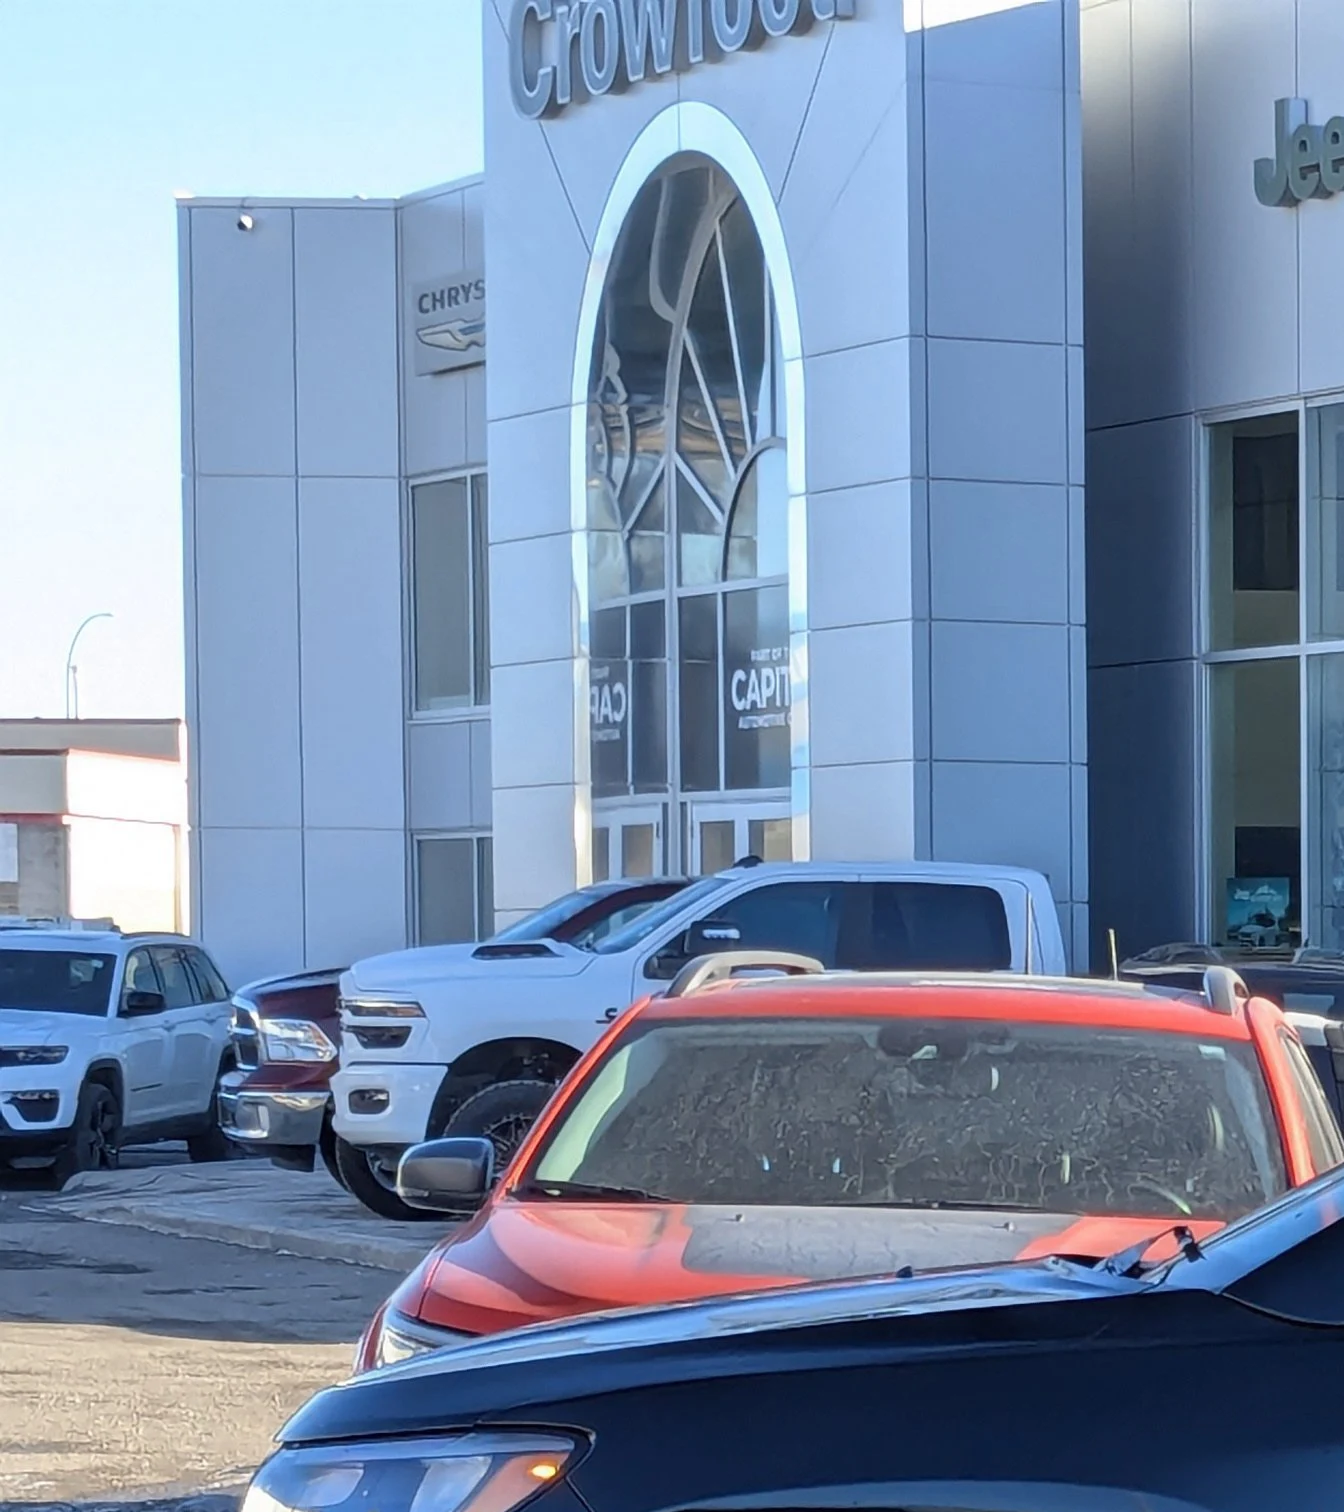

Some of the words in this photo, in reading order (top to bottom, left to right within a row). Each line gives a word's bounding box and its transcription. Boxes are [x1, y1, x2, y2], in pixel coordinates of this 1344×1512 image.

[509, 0, 856, 119] Crowo
[417, 279, 486, 314] CHRYS
[731, 666, 790, 711] CAPIT
